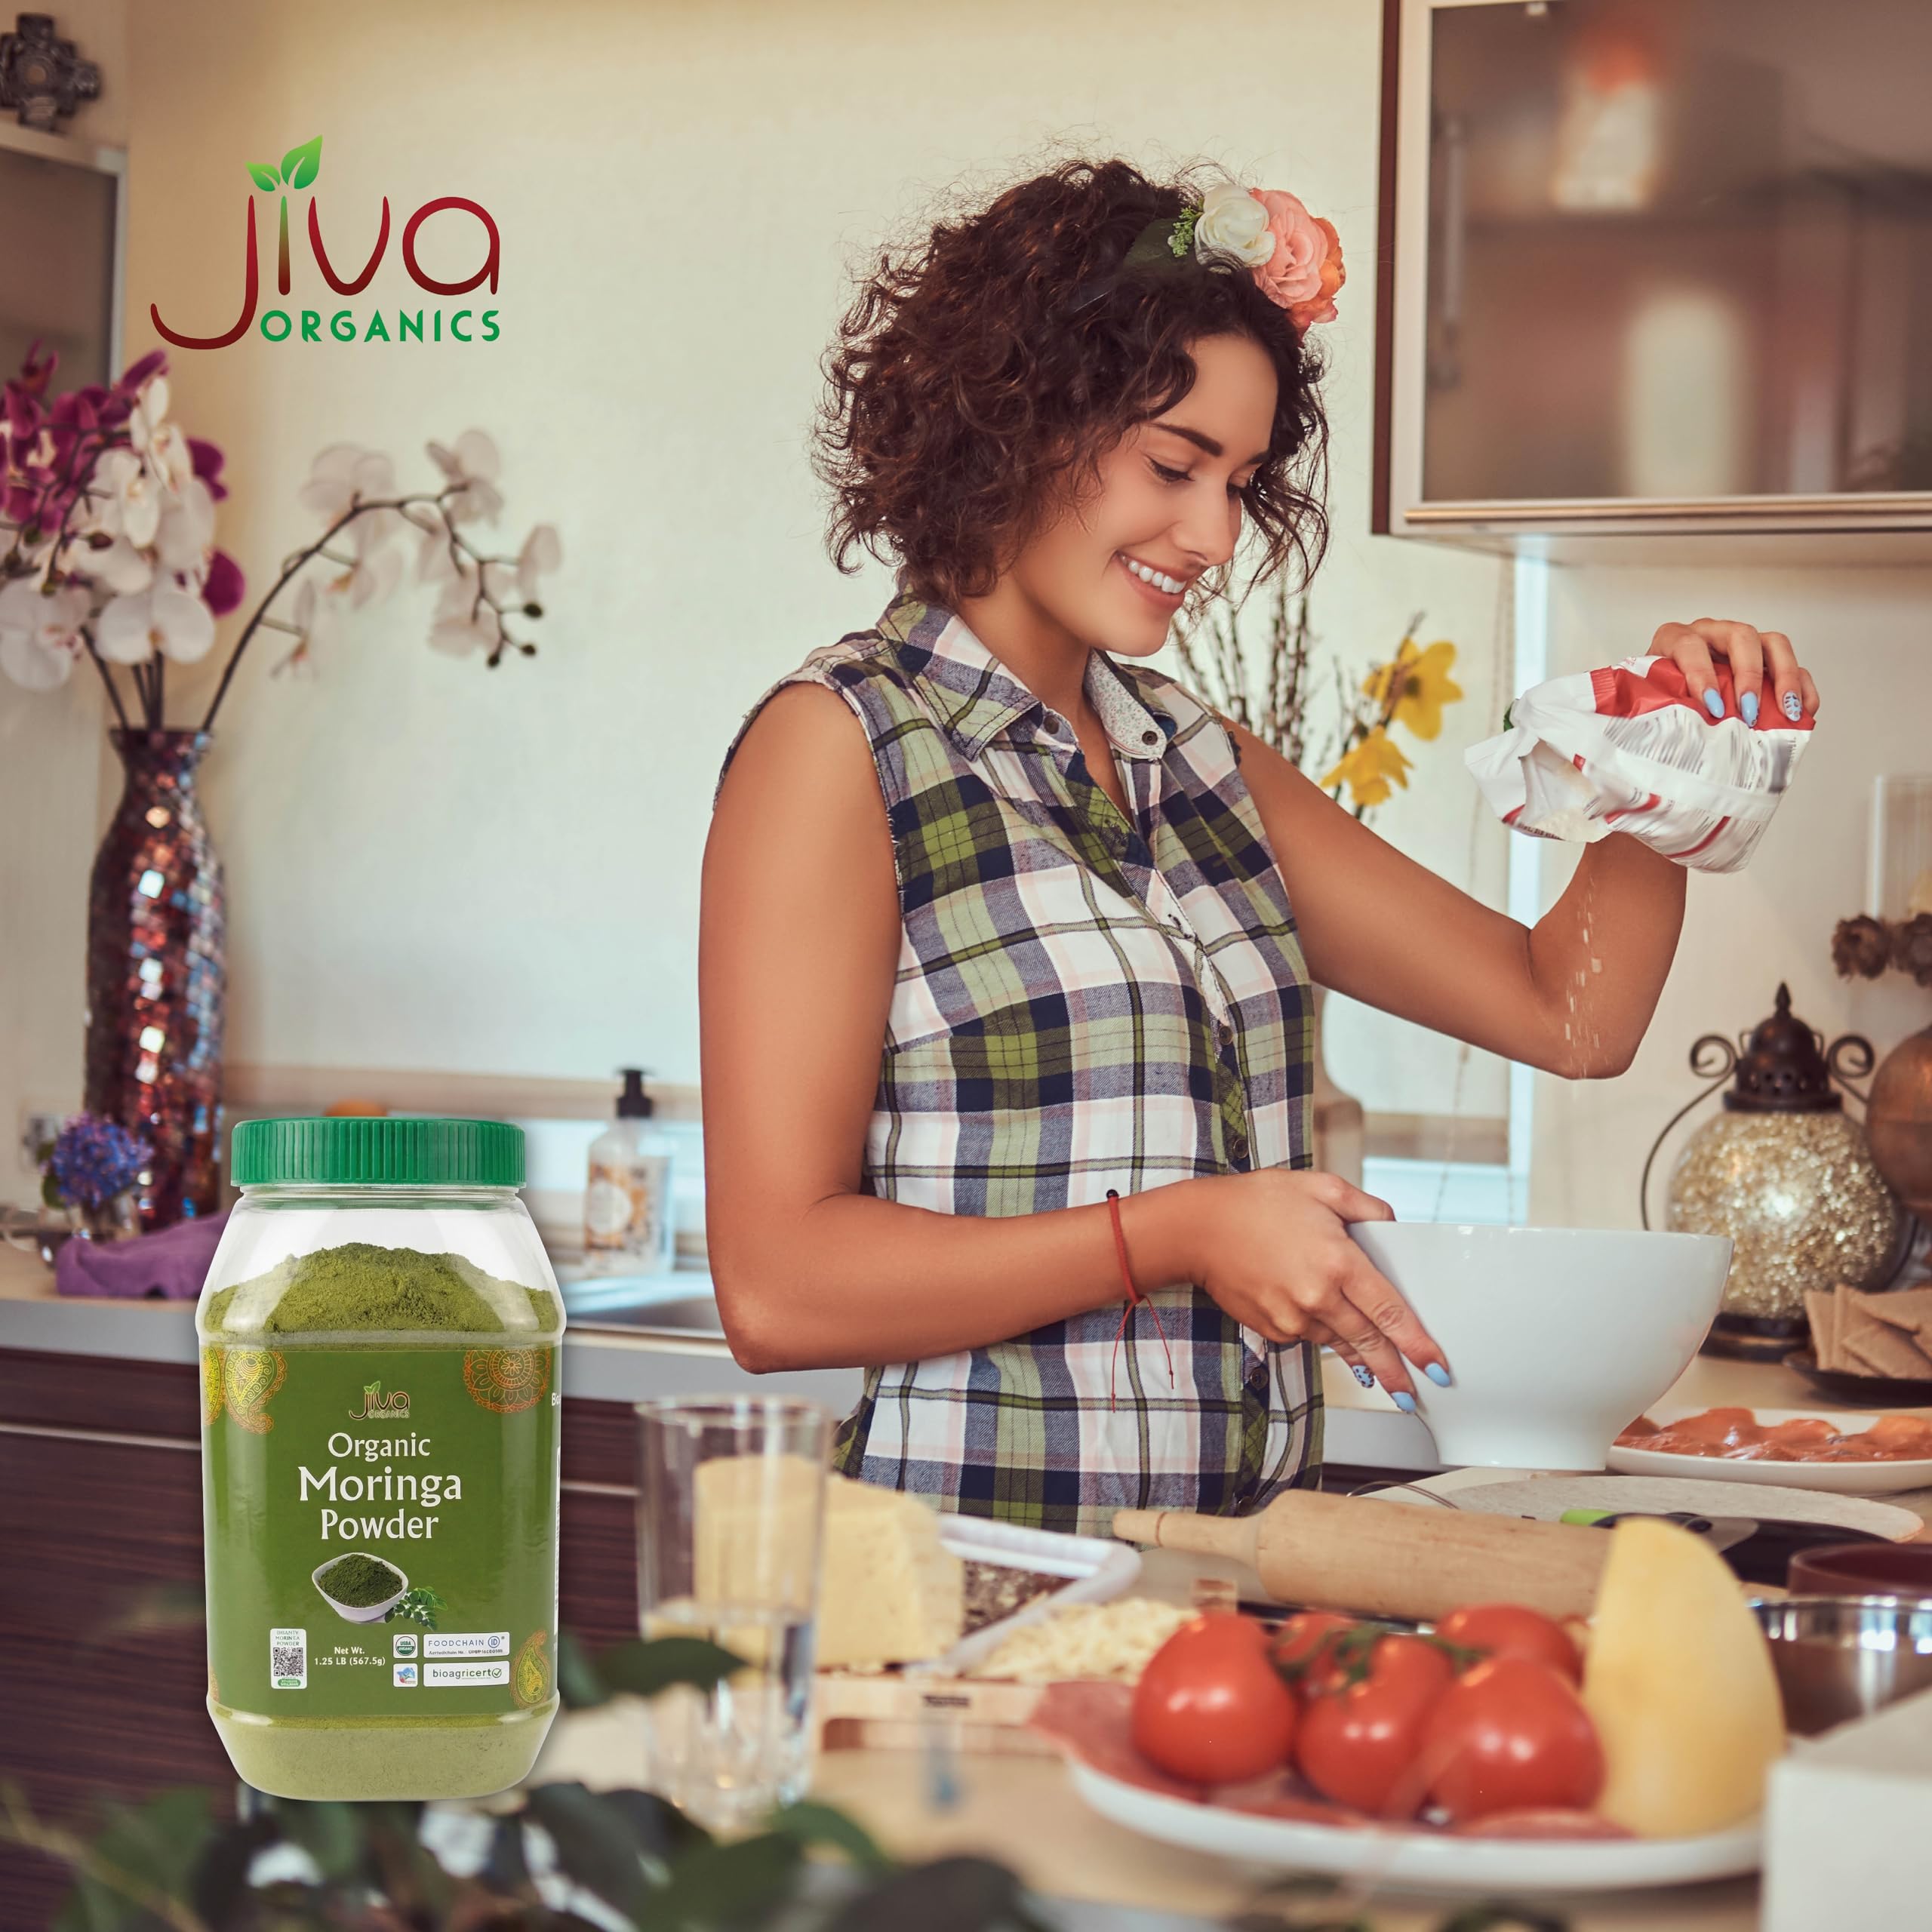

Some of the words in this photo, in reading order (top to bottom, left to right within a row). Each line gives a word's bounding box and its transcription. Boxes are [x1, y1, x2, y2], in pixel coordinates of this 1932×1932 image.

[368, 1410, 410, 1419] ORGANICS
[328, 1432, 431, 1463] Organic
[297, 1466, 462, 1508] Moringa
[321, 1509, 439, 1540] Powder
[334, 1647, 349, 1655] Net
[351, 1647, 365, 1655] Wt.
[315, 1657, 333, 1666] 1.25
[336, 1657, 347, 1666] LB
[349, 1657, 386, 1666] (567.5g)
[432, 1668, 491, 1679] bioagricert
